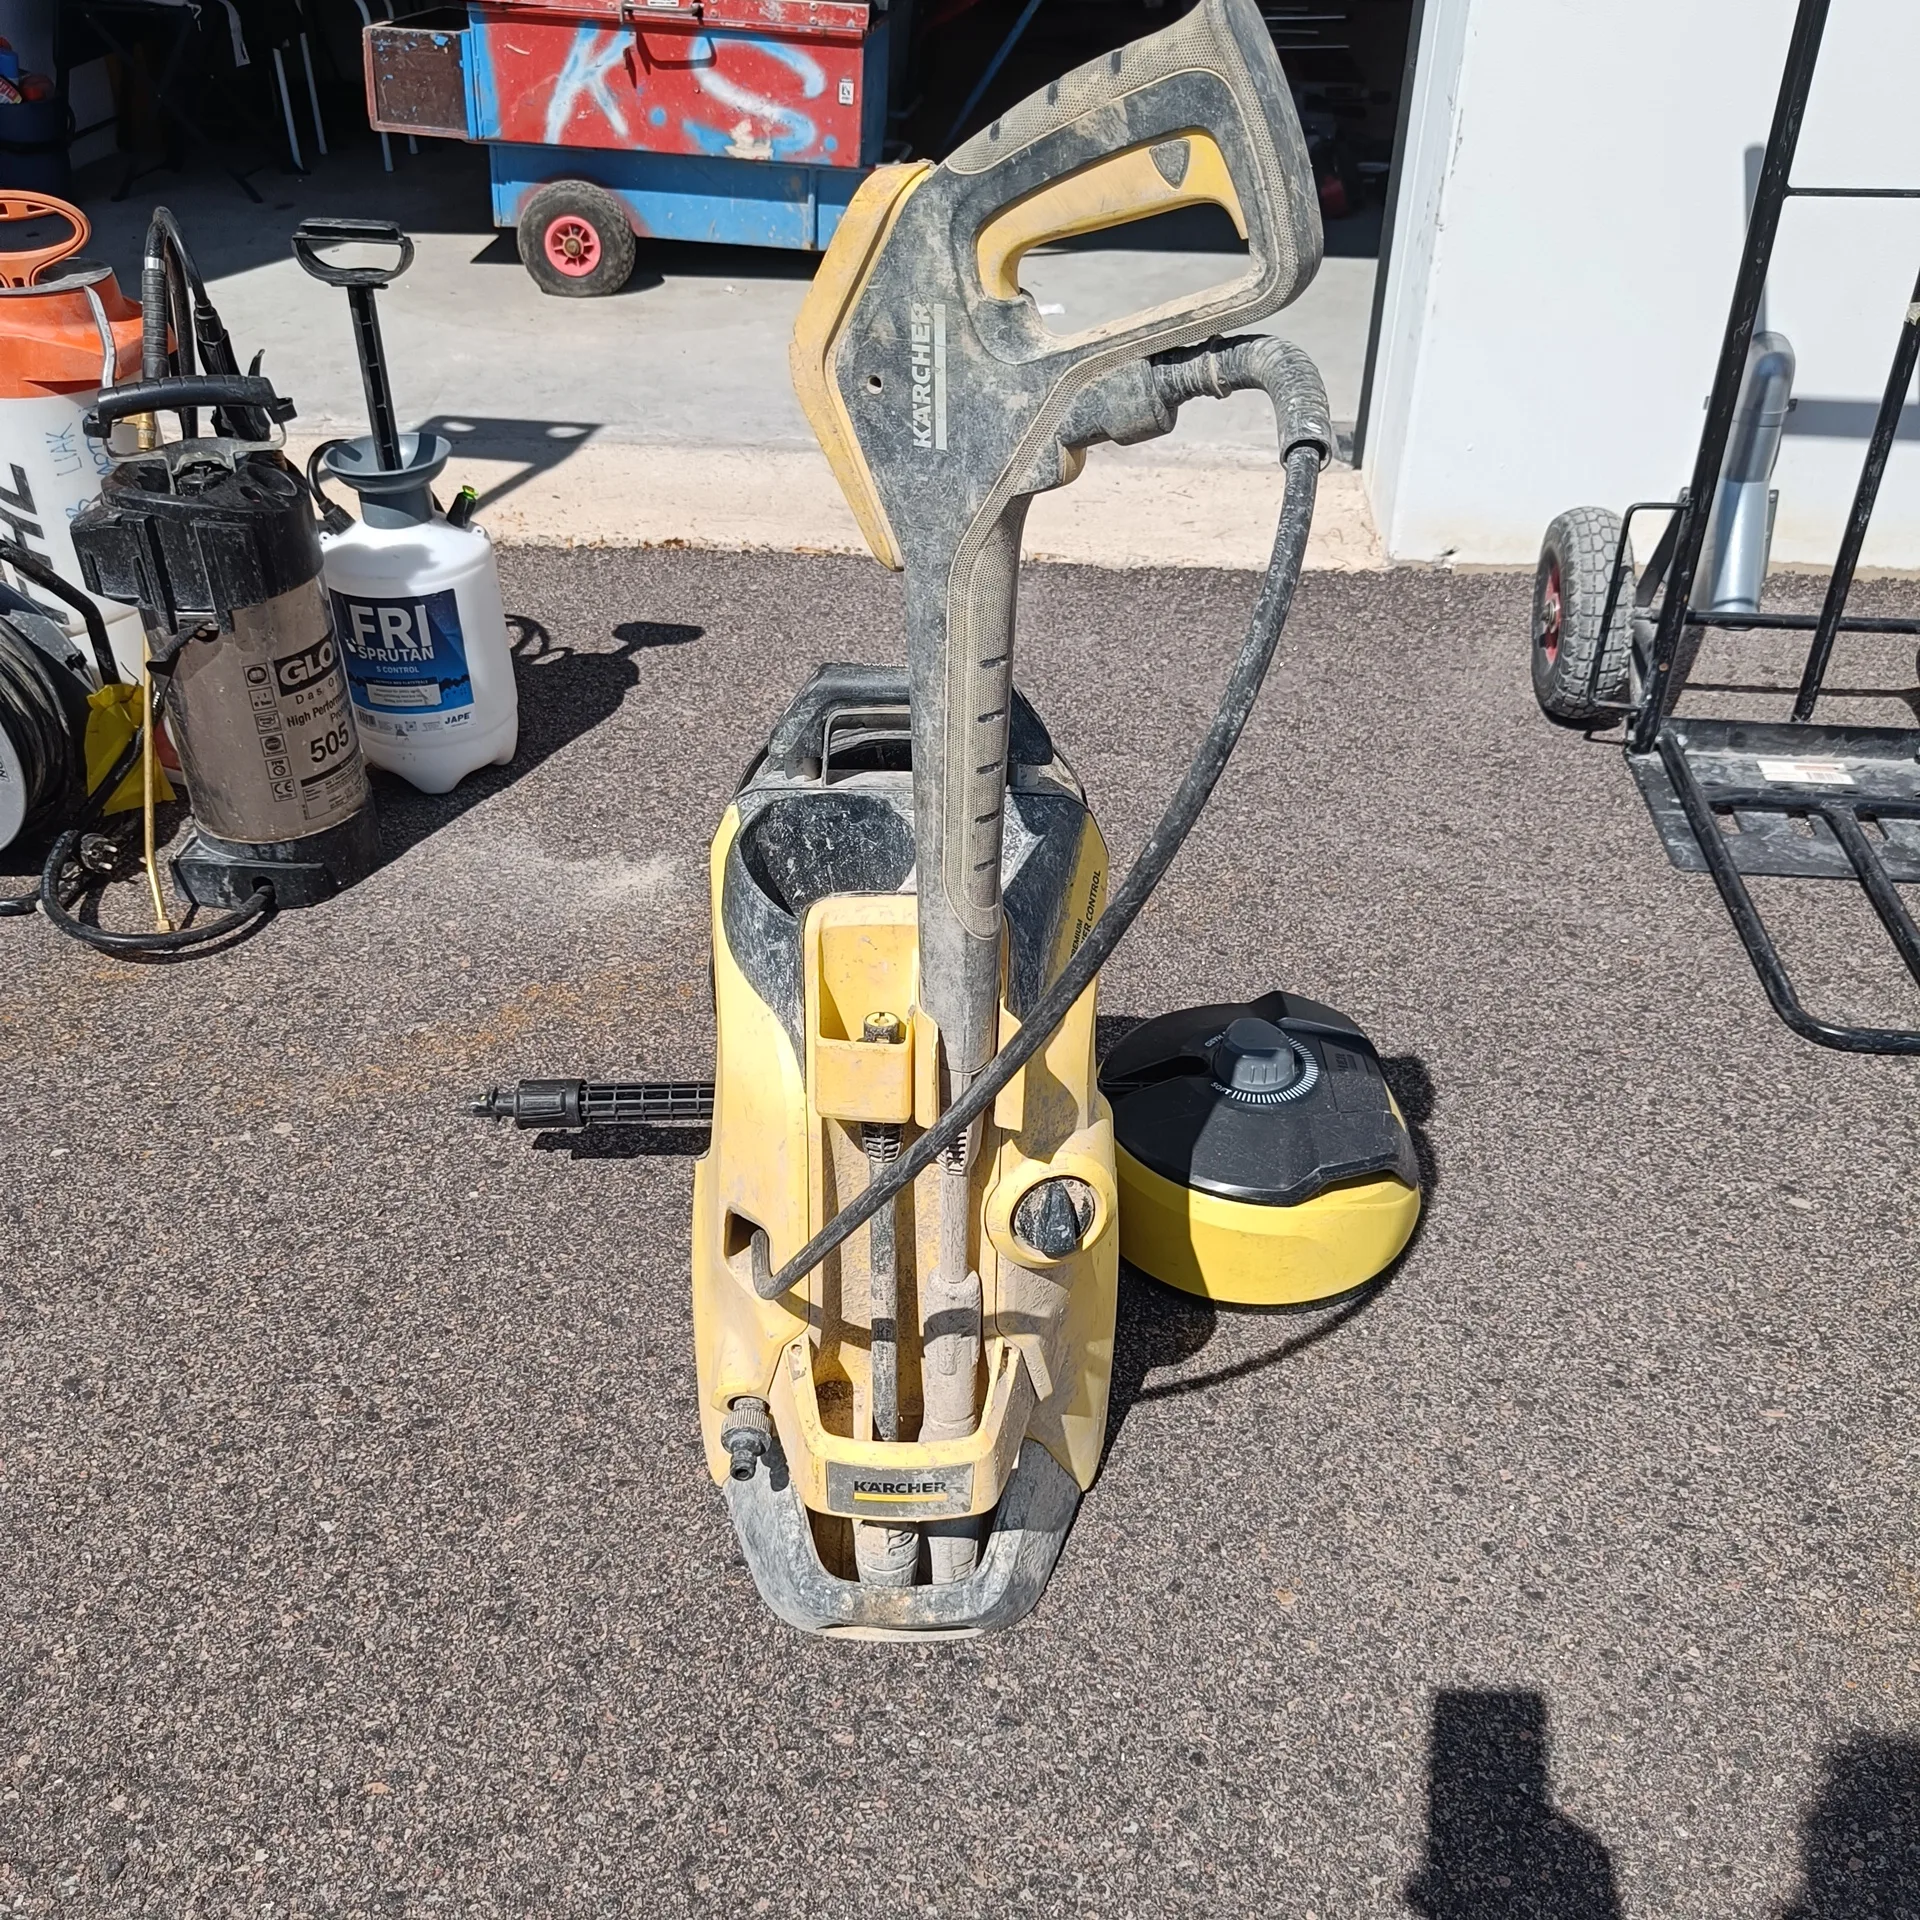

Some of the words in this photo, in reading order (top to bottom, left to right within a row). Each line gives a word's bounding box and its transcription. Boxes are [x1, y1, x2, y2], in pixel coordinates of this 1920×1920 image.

[911, 302, 931, 448] KÄRCHER
[349, 604, 433, 649] FRI
[358, 645, 435, 662] SPRUTAN
[383, 666, 419, 674] CONTROL
[295, 688, 322, 705] Das
[286, 712, 311, 728] High
[444, 711, 471, 725] JAPE
[311, 721, 349, 763] 505
[1086, 870, 1101, 922] CONTROL
[1210, 1081, 1233, 1095] SOFT
[854, 1480, 947, 1494] KÄRCHER
